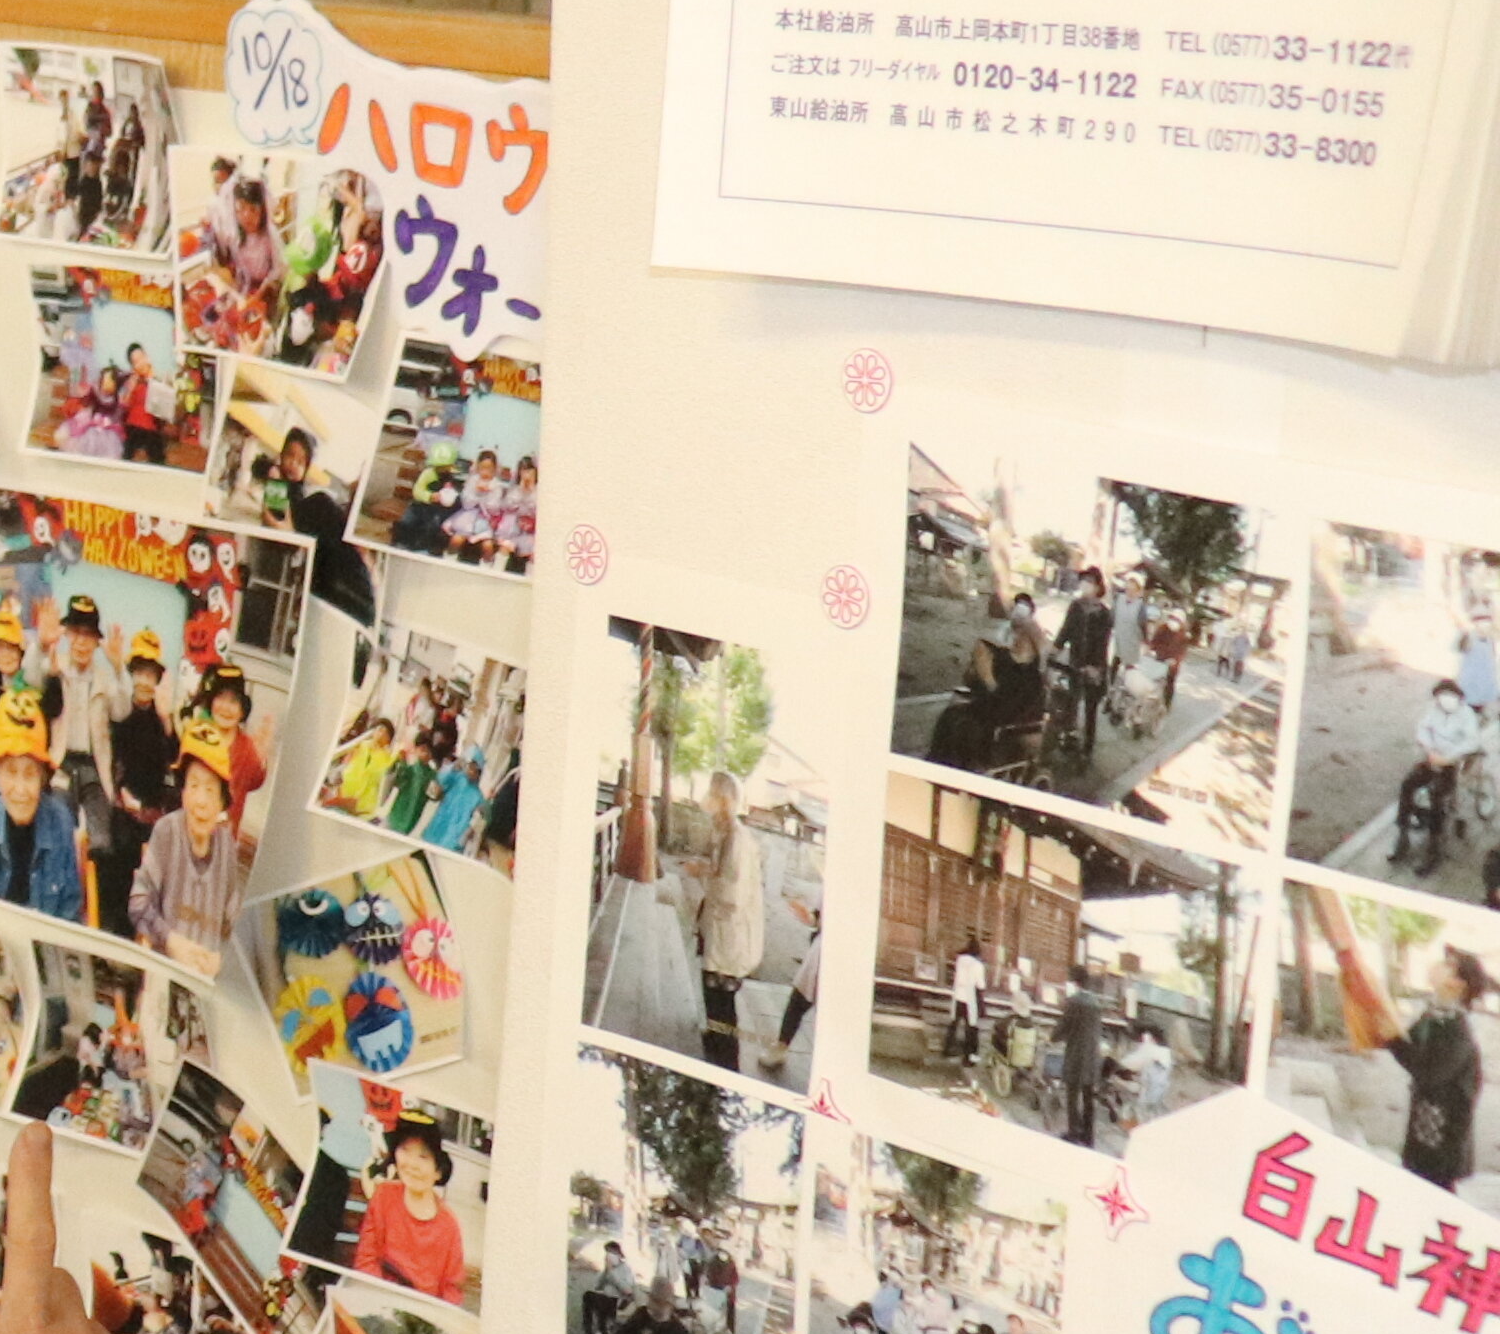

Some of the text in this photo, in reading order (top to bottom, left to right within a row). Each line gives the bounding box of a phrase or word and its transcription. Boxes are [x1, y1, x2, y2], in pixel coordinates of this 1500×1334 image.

[774, 8, 875, 36] 本社給油所
[1164, 30, 1207, 54] TEL
[241, 28, 311, 110] 10/18
[771, 53, 842, 78] ご注文は
[848, 57, 941, 82] フリーダイヤル
[953, 61, 1138, 99] 0120-34-1122
[1160, 77, 1205, 101] FAX
[769, 95, 869, 124] 東山給油所
[1158, 124, 1200, 148] TEL
[316, 82, 548, 215] ハロウ
